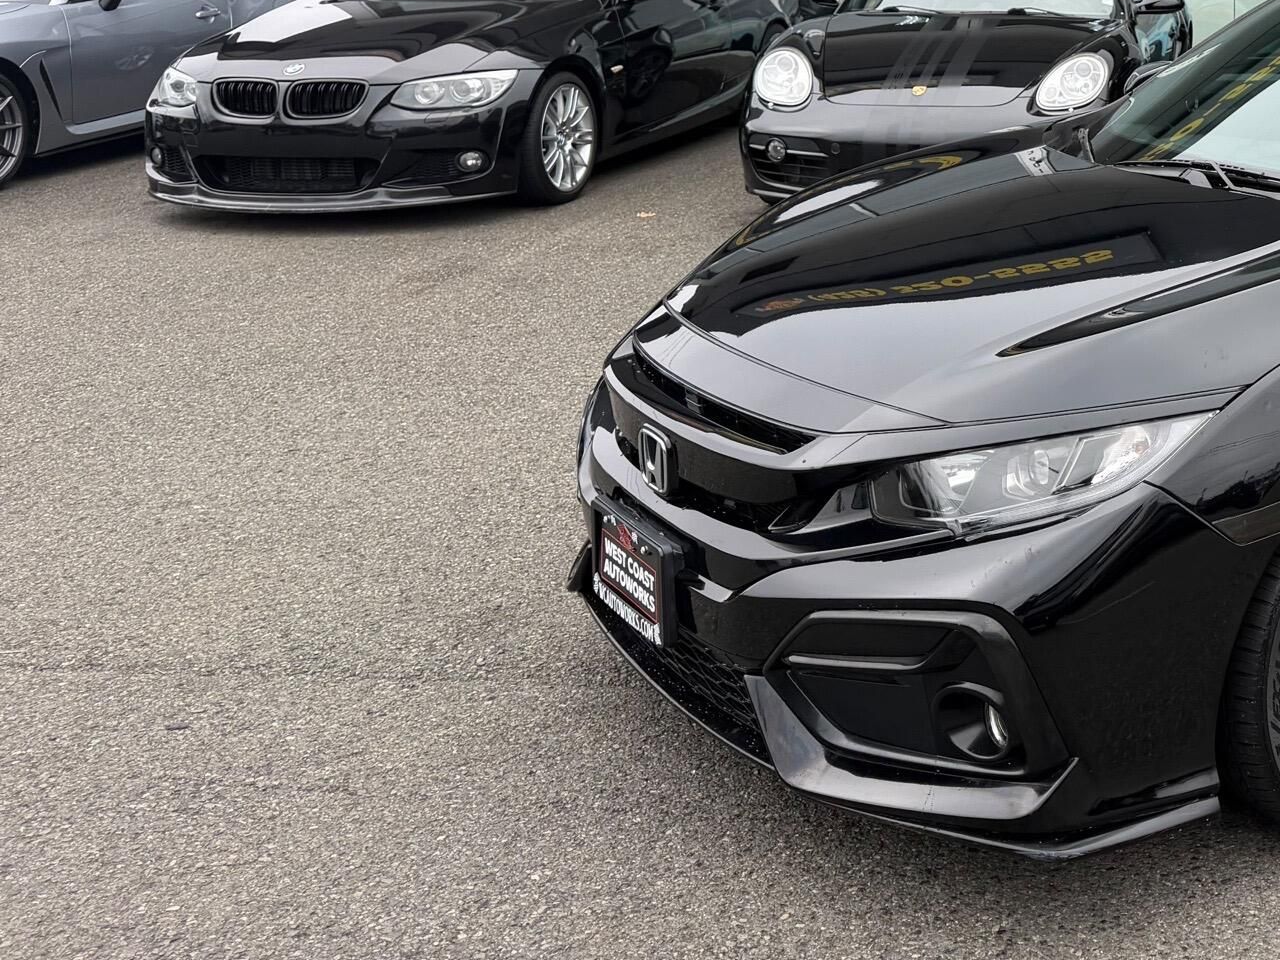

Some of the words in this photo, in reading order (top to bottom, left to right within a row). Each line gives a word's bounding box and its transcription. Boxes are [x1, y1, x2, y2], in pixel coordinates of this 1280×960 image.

[603, 558, 656, 613] AUTOWORKS
[604, 537, 627, 568] WEST
[627, 556, 655, 591] COAST
